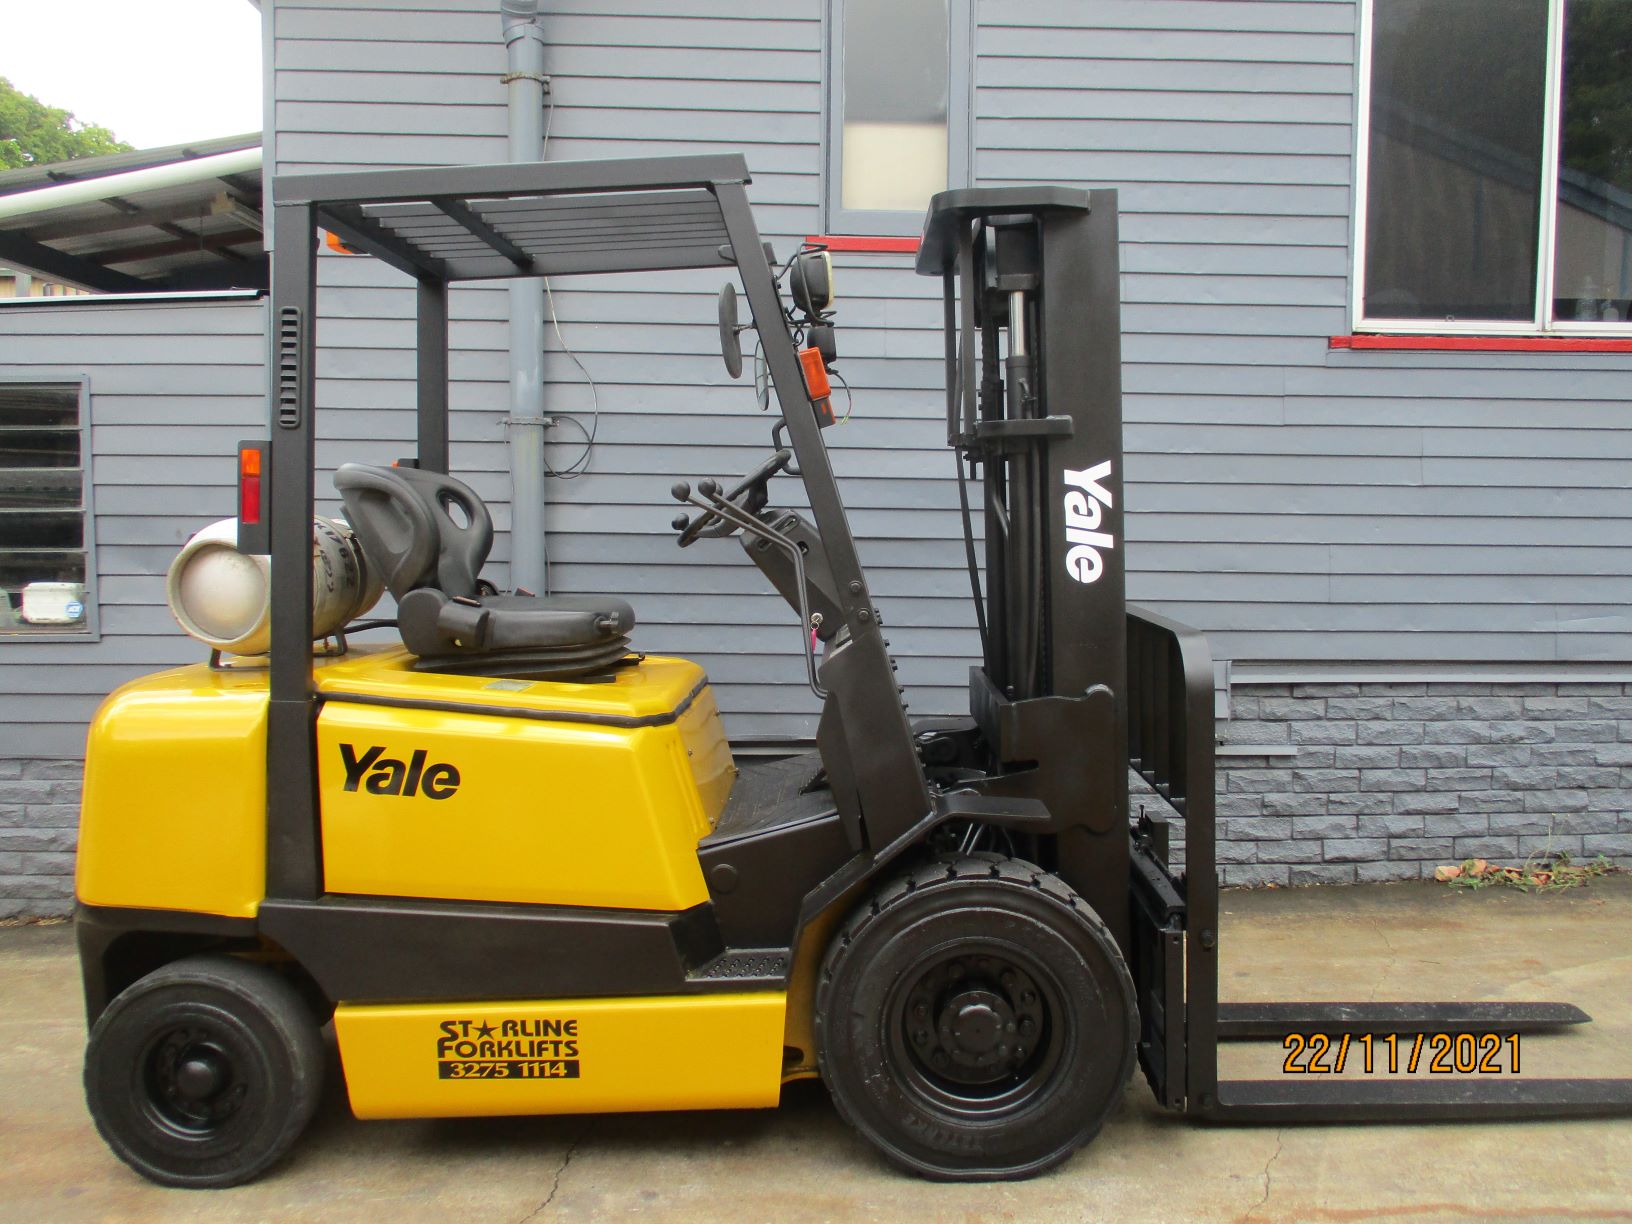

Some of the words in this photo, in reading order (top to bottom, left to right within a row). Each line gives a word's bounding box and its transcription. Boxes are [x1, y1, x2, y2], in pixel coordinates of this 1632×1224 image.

[1064, 460, 1114, 584] Yale
[339, 743, 460, 800] Yale
[437, 1036, 579, 1059] FORKLIFTS
[450, 1062, 509, 1078] 3275
[517, 1061, 567, 1077] 1114
